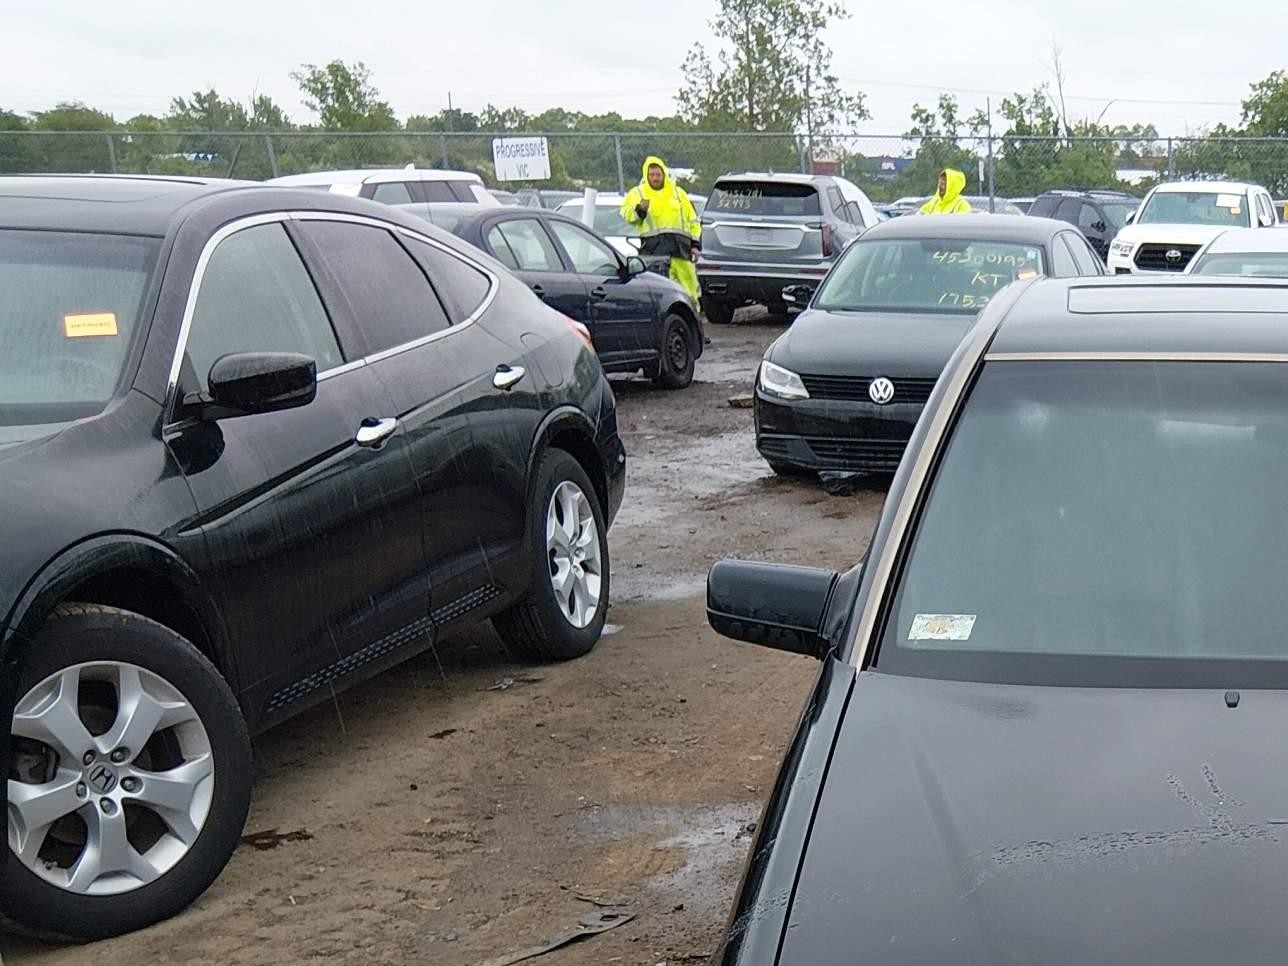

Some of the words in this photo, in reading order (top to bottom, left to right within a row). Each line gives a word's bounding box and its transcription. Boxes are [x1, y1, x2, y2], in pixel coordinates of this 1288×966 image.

[495, 142, 546, 159] PROGRESSIVE
[516, 163, 530, 178] VIC
[970, 271, 1008, 286] KT
